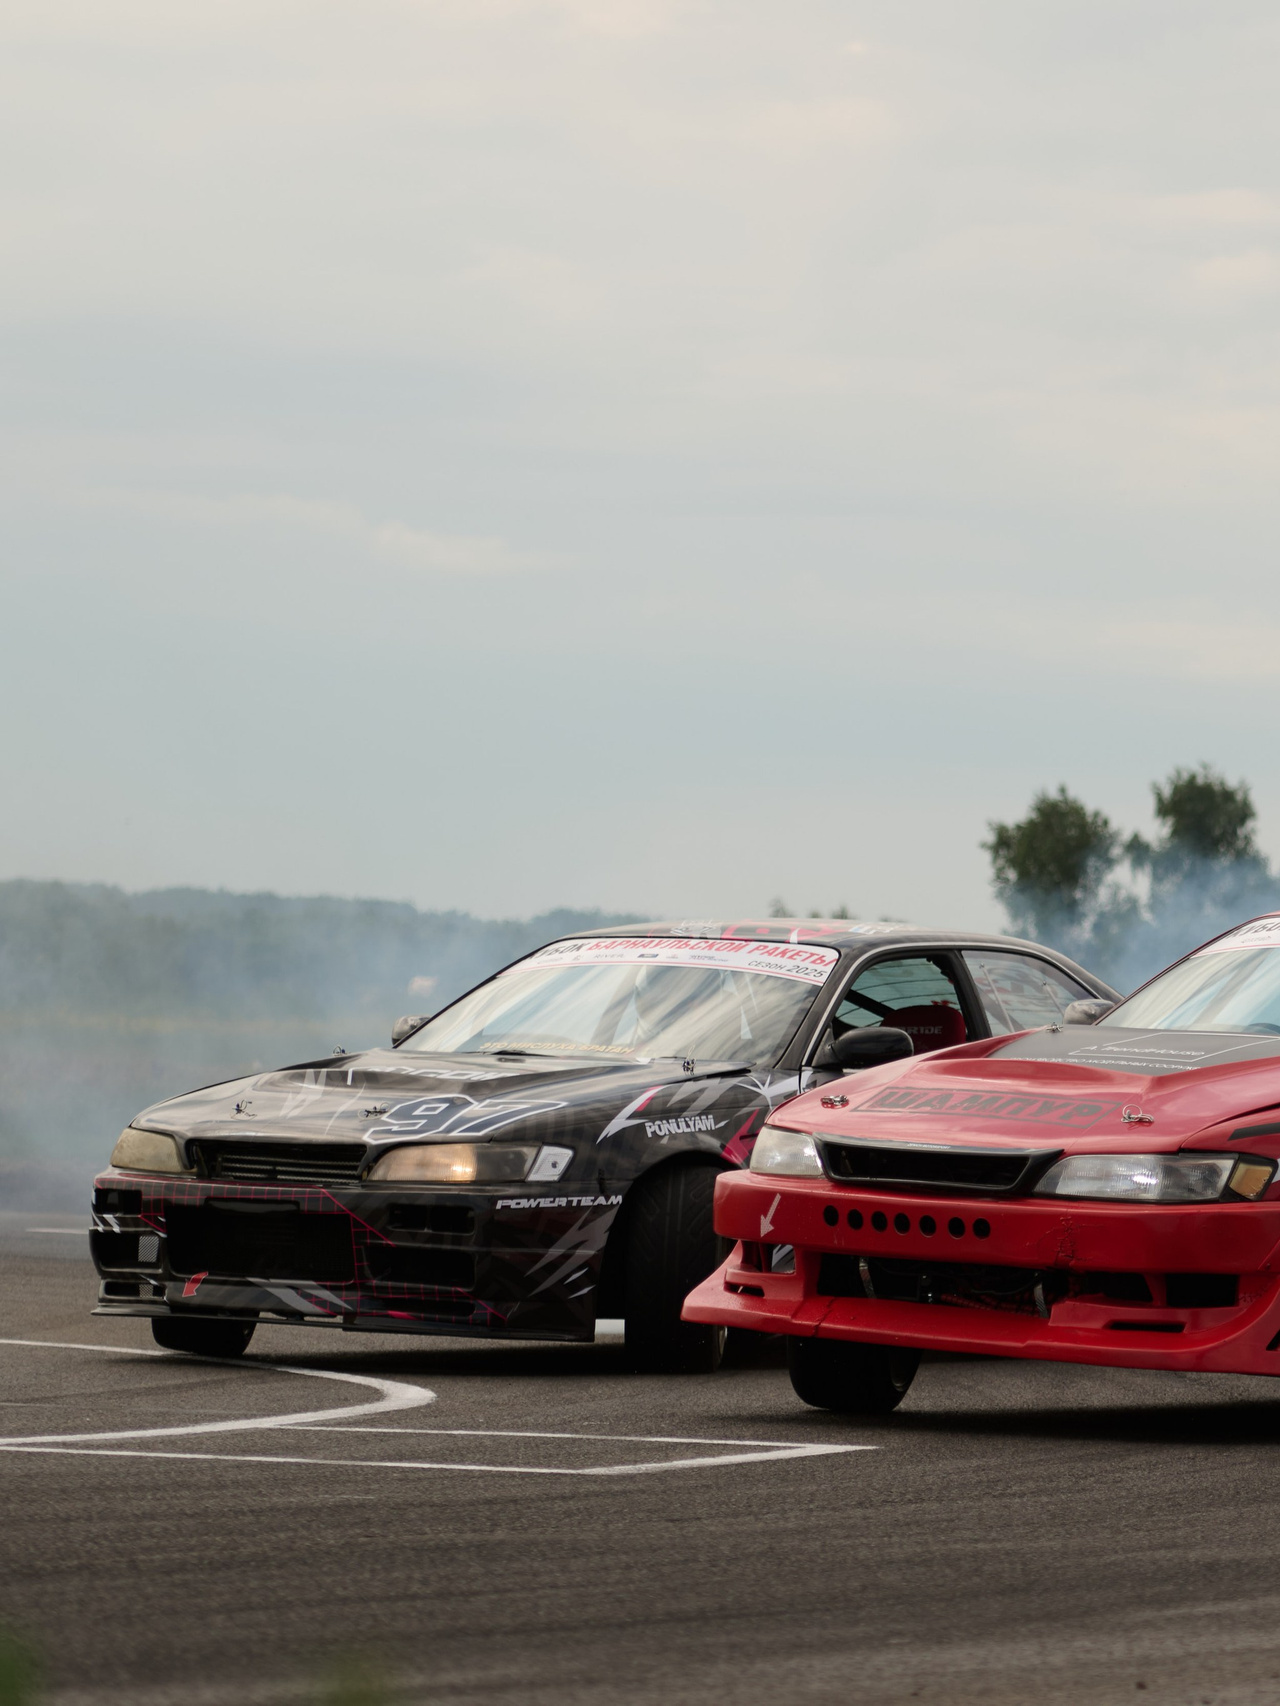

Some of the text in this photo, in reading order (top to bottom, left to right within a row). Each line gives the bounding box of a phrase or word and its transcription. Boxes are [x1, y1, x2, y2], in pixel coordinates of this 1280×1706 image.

[587, 939, 749, 953] БАРНАУЛЬСКОЙ
[748, 942, 838, 967] РАКЕТЫ
[748, 960, 828, 978] СЕЗОН 2025
[901, 1026, 943, 1034] RIDE
[868, 1091, 1104, 1121] ШАМПУР
[363, 1093, 569, 1145] 97
[645, 1115, 715, 1138] PONULYAM
